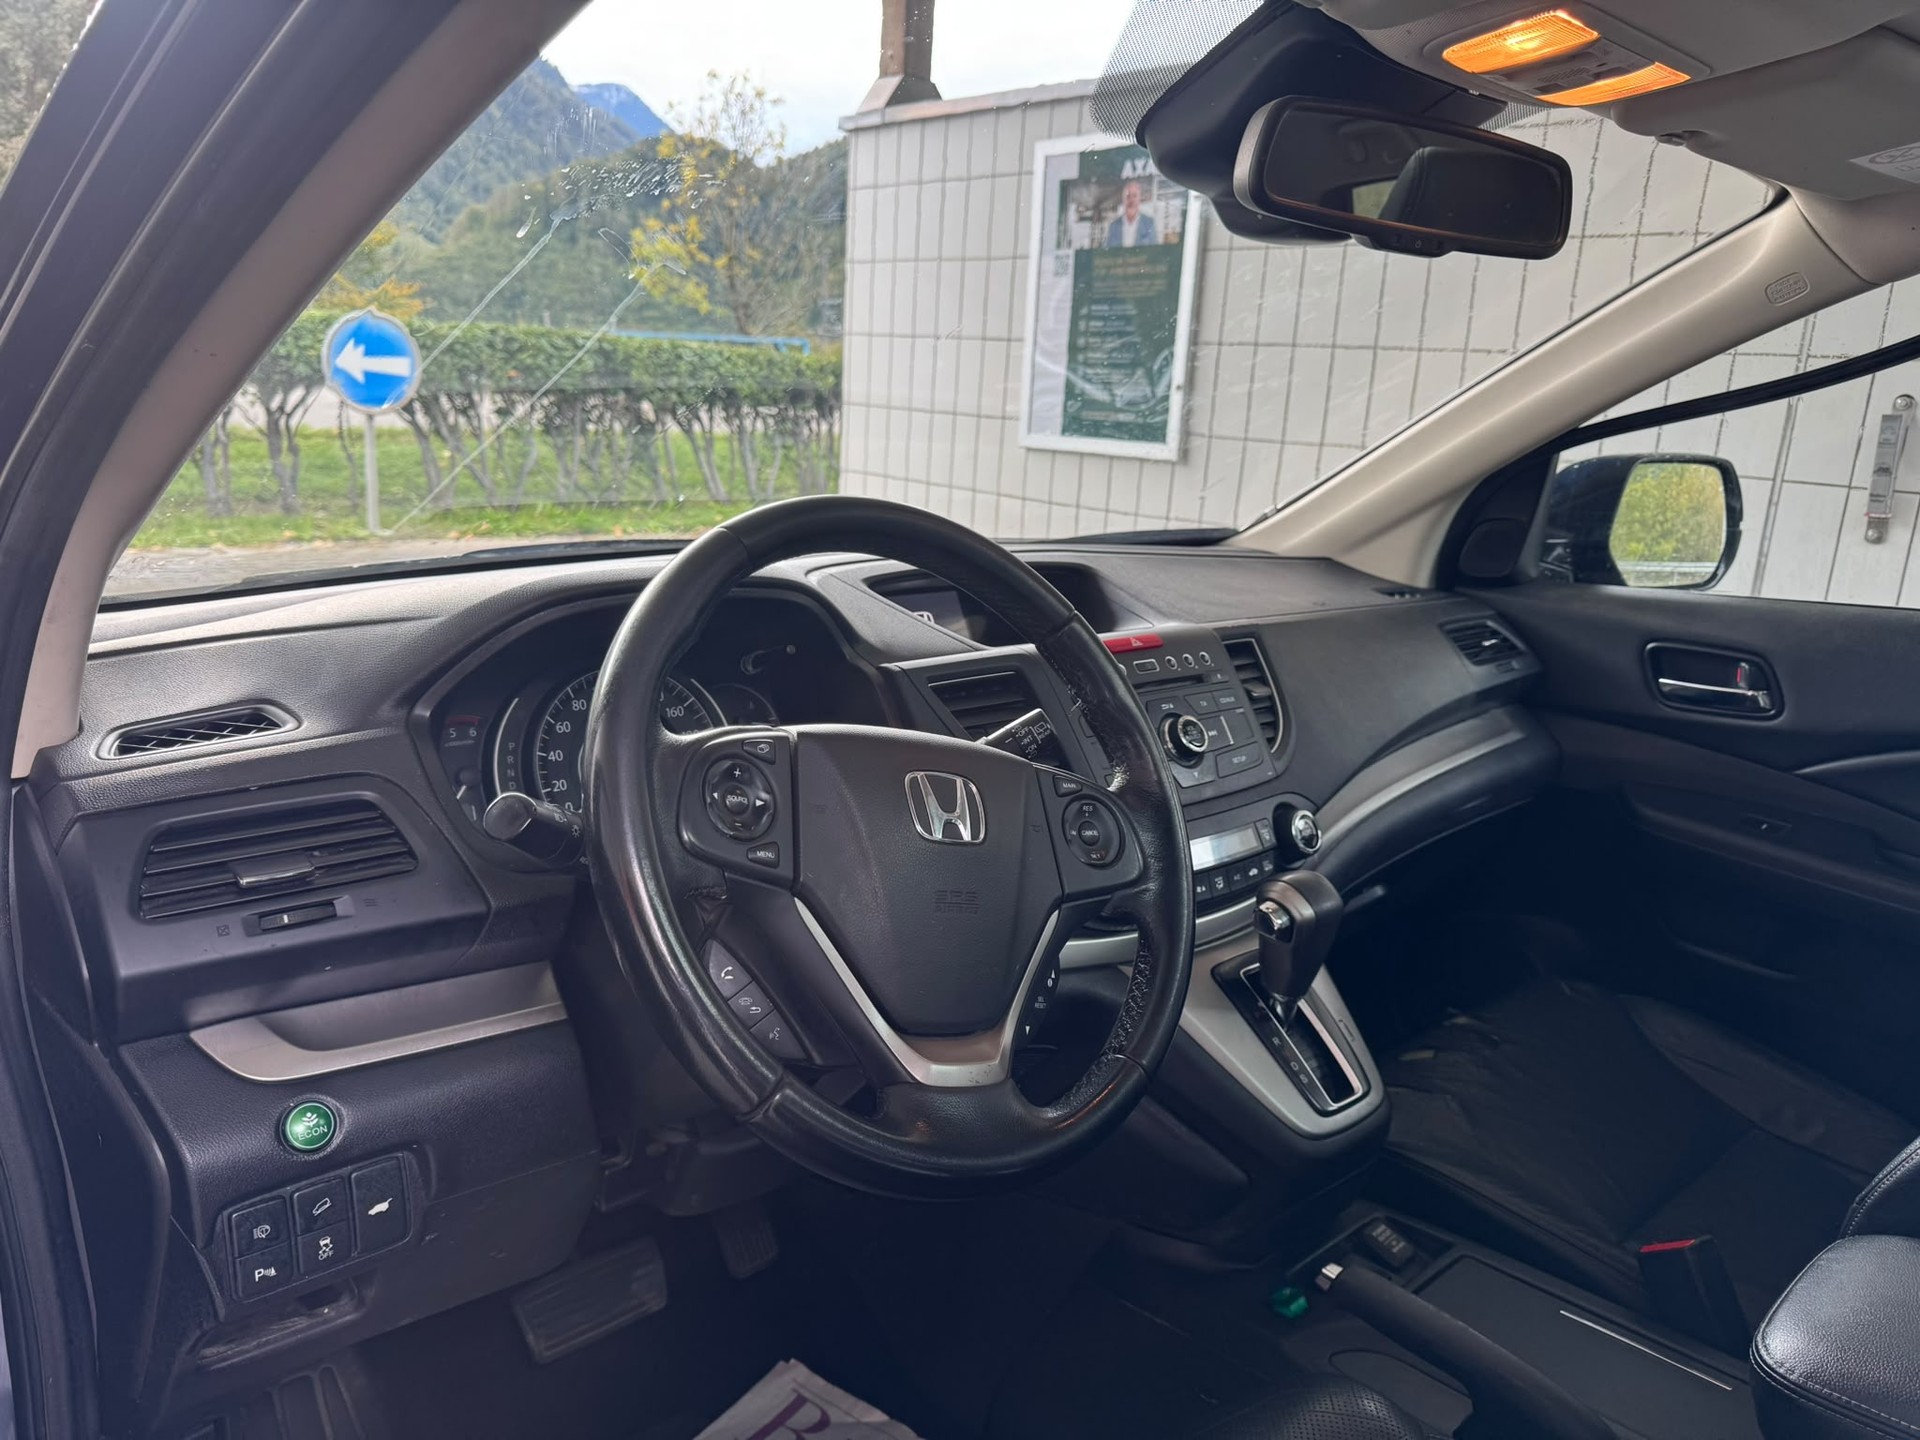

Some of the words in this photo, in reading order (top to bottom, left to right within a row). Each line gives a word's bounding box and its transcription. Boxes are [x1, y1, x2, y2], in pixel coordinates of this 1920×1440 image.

[571, 698, 588, 712] 80
[665, 705, 685, 718] 160
[449, 727, 457, 738] 5
[469, 727, 477, 738] 6
[555, 721, 571, 734] 60
[507, 742, 516, 751] P
[506, 756, 515, 764] R
[547, 749, 564, 762] 40
[506, 769, 515, 778] N
[551, 779, 568, 793] 20
[756, 850, 776, 859] MENU
[298, 1125, 328, 1141] ECON
[318, 1250, 334, 1261] OFF
